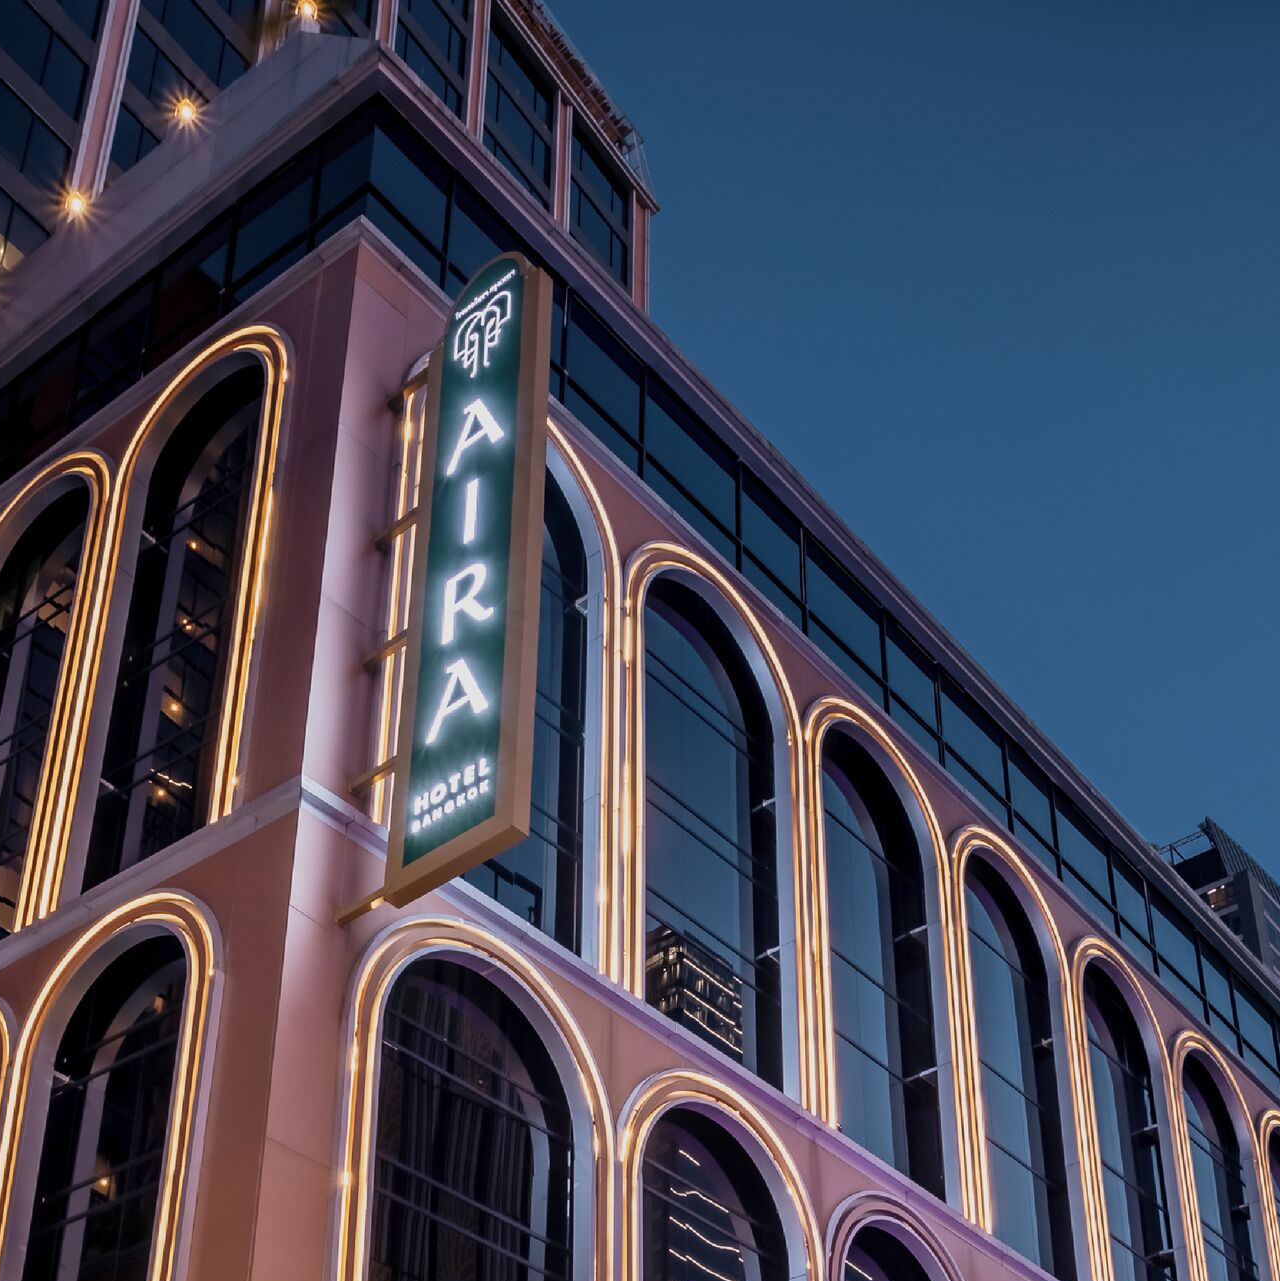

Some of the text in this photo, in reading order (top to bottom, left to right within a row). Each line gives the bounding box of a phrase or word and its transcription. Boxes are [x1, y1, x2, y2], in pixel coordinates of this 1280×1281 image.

[425, 397, 506, 745] AIRA
[411, 779, 489, 834] BANGKOK
[413, 757, 490, 816] HOTEL
